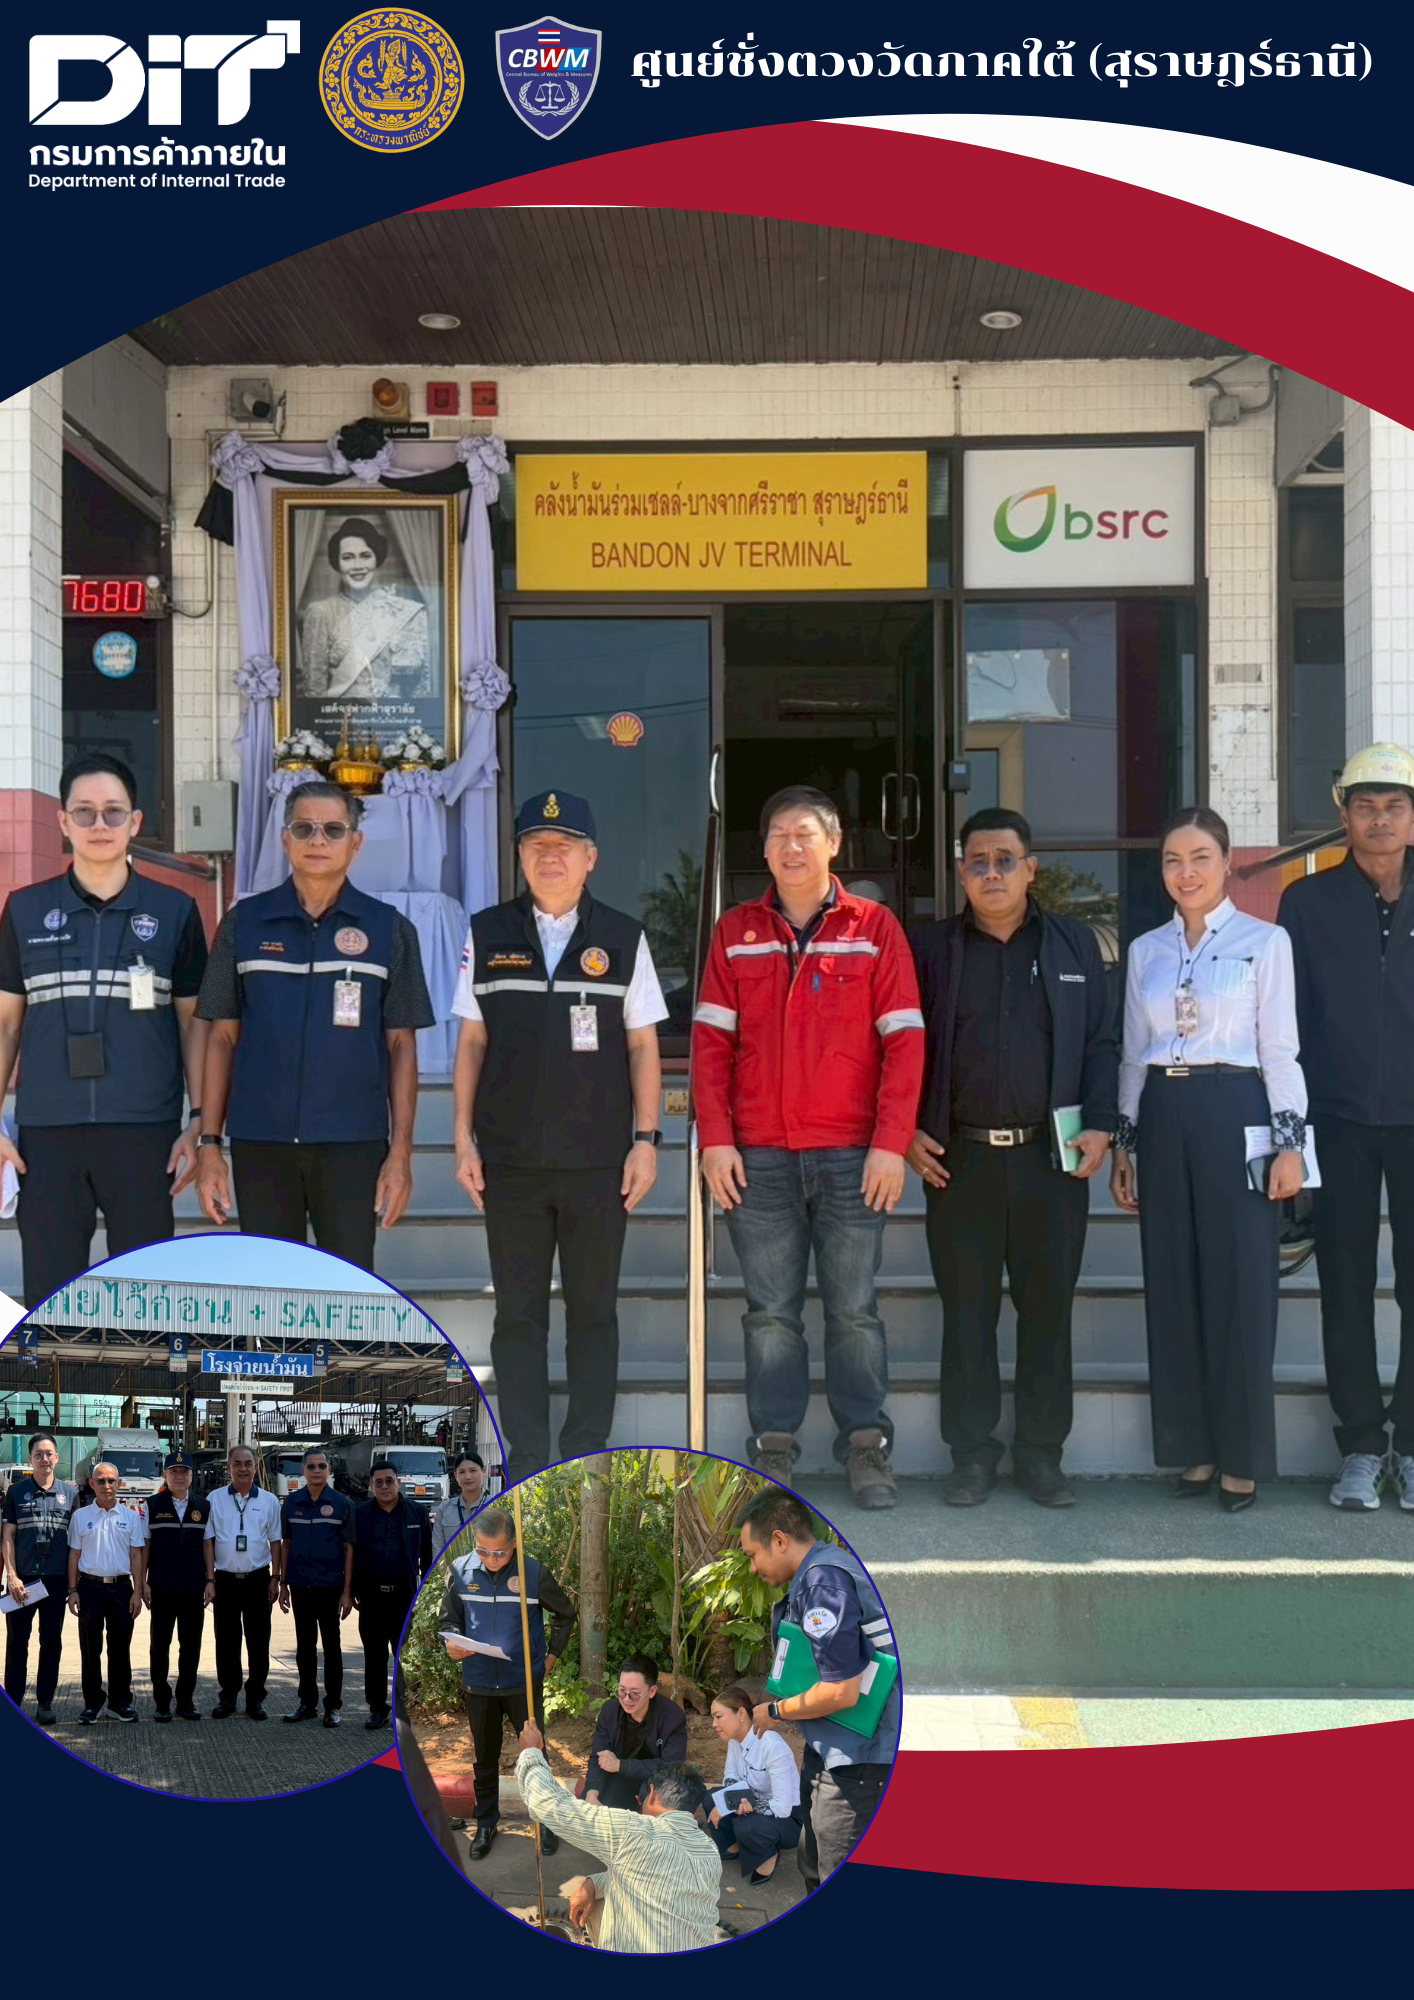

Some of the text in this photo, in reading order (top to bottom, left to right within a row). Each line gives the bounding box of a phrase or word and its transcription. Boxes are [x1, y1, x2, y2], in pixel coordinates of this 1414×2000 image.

[535, 471, 908, 526] คลังน้ำมันร่วมเชลล์-บางจากศรีราชา สุราษฎร์ธานี
[1064, 503, 1169, 540] bsrc
[592, 541, 852, 568] BANDON JV TERMINAL
[63, 581, 142, 612] 7680
[280, 1301, 412, 1331] SAFETY
[23, 1330, 33, 1344] 7
[173, 1338, 183, 1352] 6
[316, 1344, 325, 1357] 5
[206, 1352, 308, 1376] โรงจ่ายน้ำมัน
